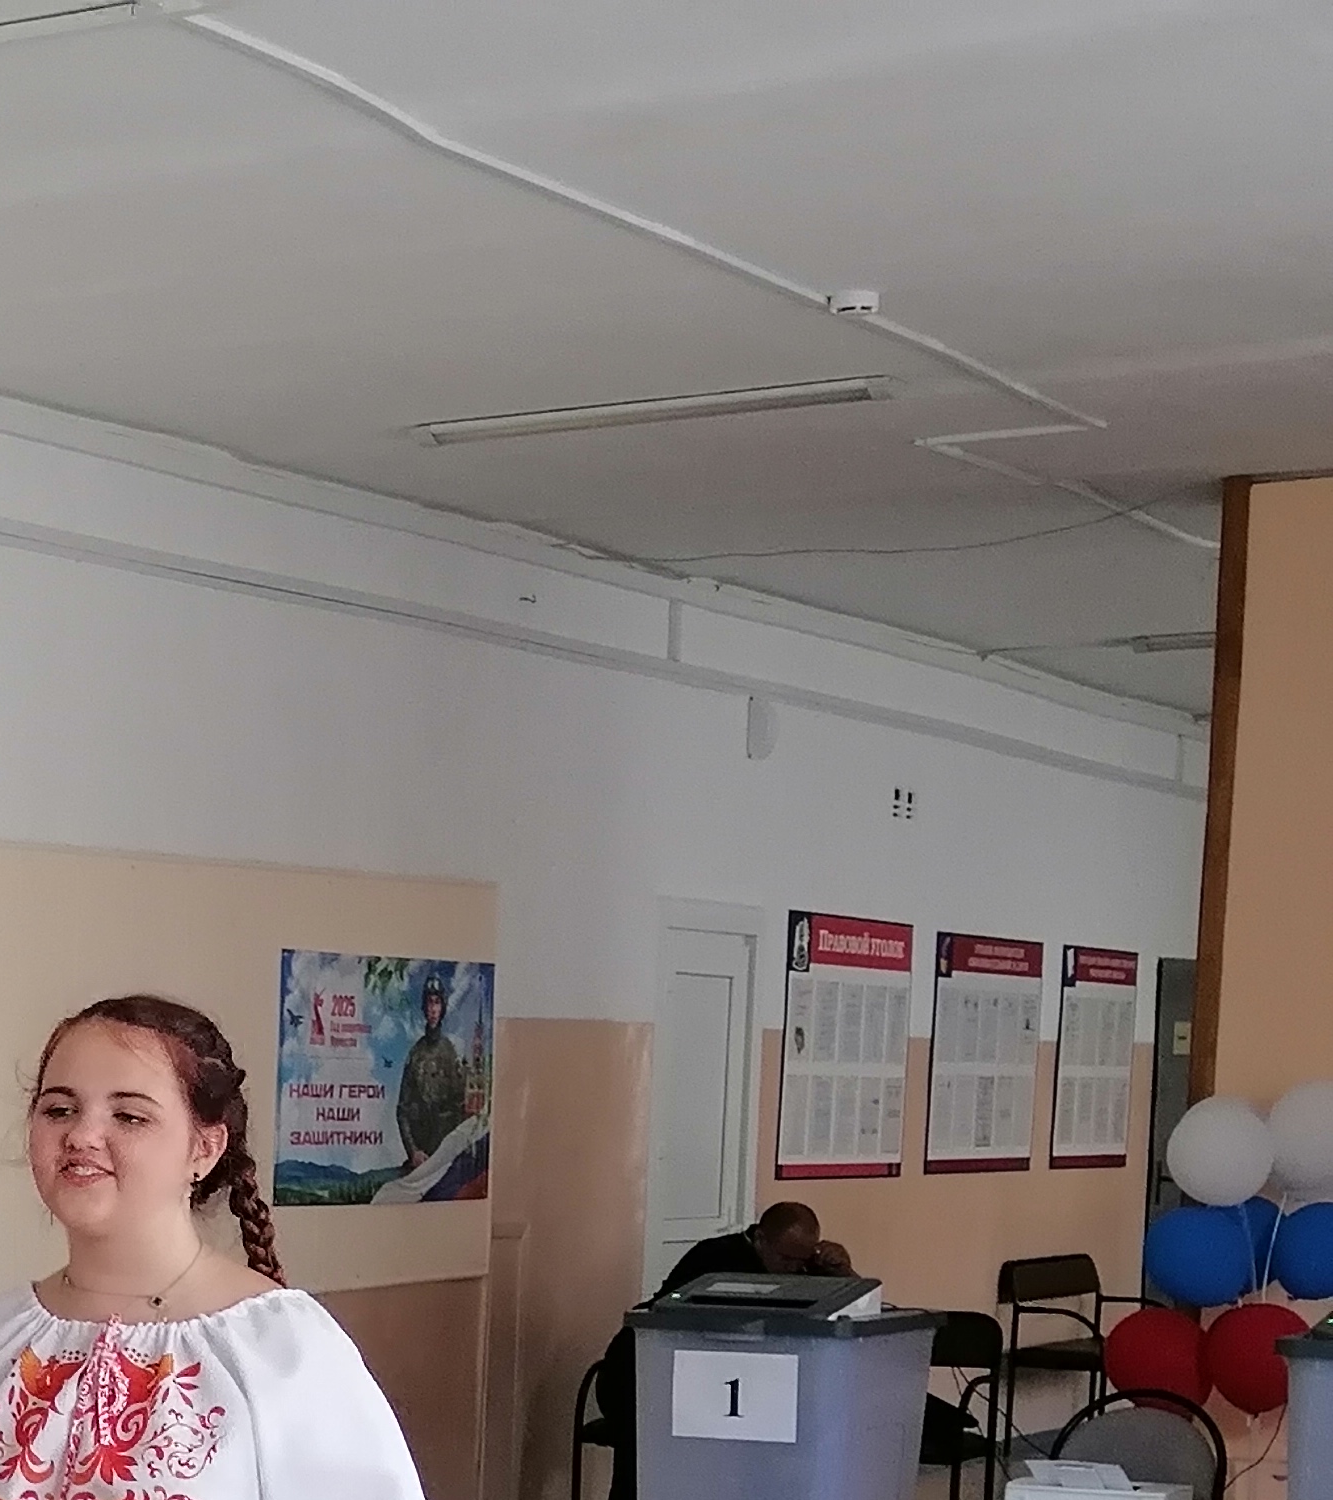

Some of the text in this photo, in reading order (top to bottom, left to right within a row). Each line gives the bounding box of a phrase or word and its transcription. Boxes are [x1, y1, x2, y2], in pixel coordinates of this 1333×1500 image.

[289, 1083, 386, 1100] НАШИ ГЕРОИ
[315, 1107, 361, 1122] НАШИ
[723, 1377, 745, 1418] 1
